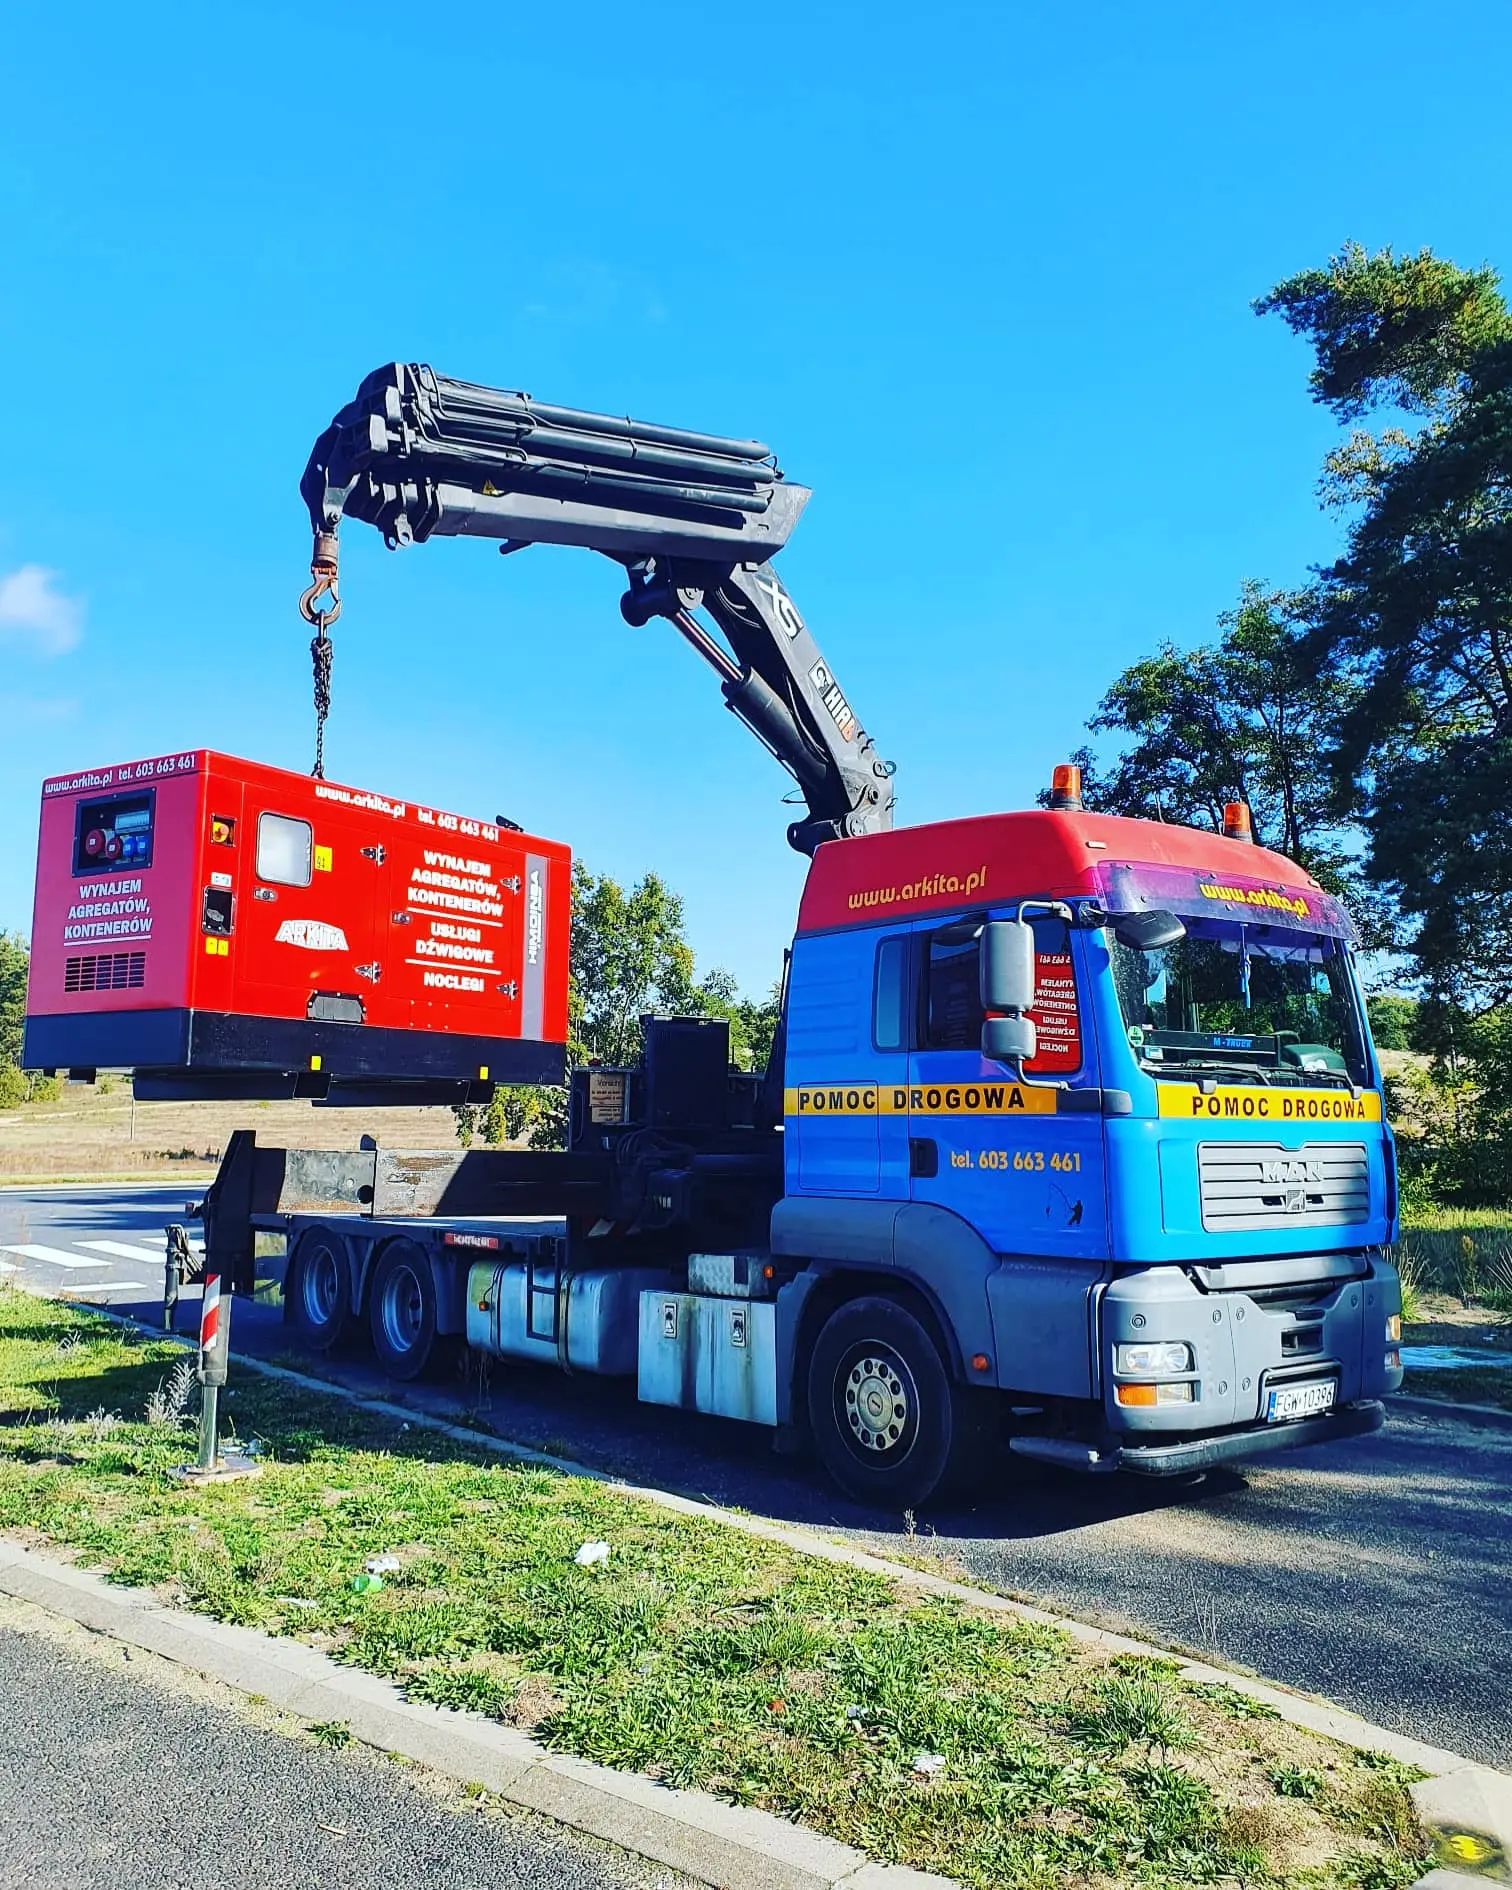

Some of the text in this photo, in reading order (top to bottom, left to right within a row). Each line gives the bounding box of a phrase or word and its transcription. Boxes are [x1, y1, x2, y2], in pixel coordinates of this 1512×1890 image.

[759, 579, 804, 640] XS
[823, 683, 857, 742] HIAB
[45, 754, 195, 793] www.arkita.pl tel. 603 663 461
[315, 784, 499, 842] www.arkita.pl tel. 603 663 461
[423, 850, 491, 877] WYNAJEM
[79, 878, 142, 899] WYNAJEM
[411, 867, 501, 900] AGREGATÓW,
[848, 866, 986, 910] www.arkita.pl
[67, 896, 150, 919] AGREGATÓW,
[407, 887, 504, 917] KONTENERÓW
[1200, 883, 1310, 918] www.arkita.pl
[64, 915, 153, 939] KONTENERÓW
[275, 919, 349, 951] ARKITA
[431, 922, 481, 943] USŁUGI
[415, 938, 494, 963] DŹWIGOWE
[423, 971, 485, 992] NOCLEGI
[799, 1087, 1026, 1111] POMOC DROGOWA
[1192, 1096, 1366, 1119] POMOC DROGOWA
[951, 1150, 1081, 1172] tel. 603 663 461
[1261, 1160, 1324, 1183] MAN
